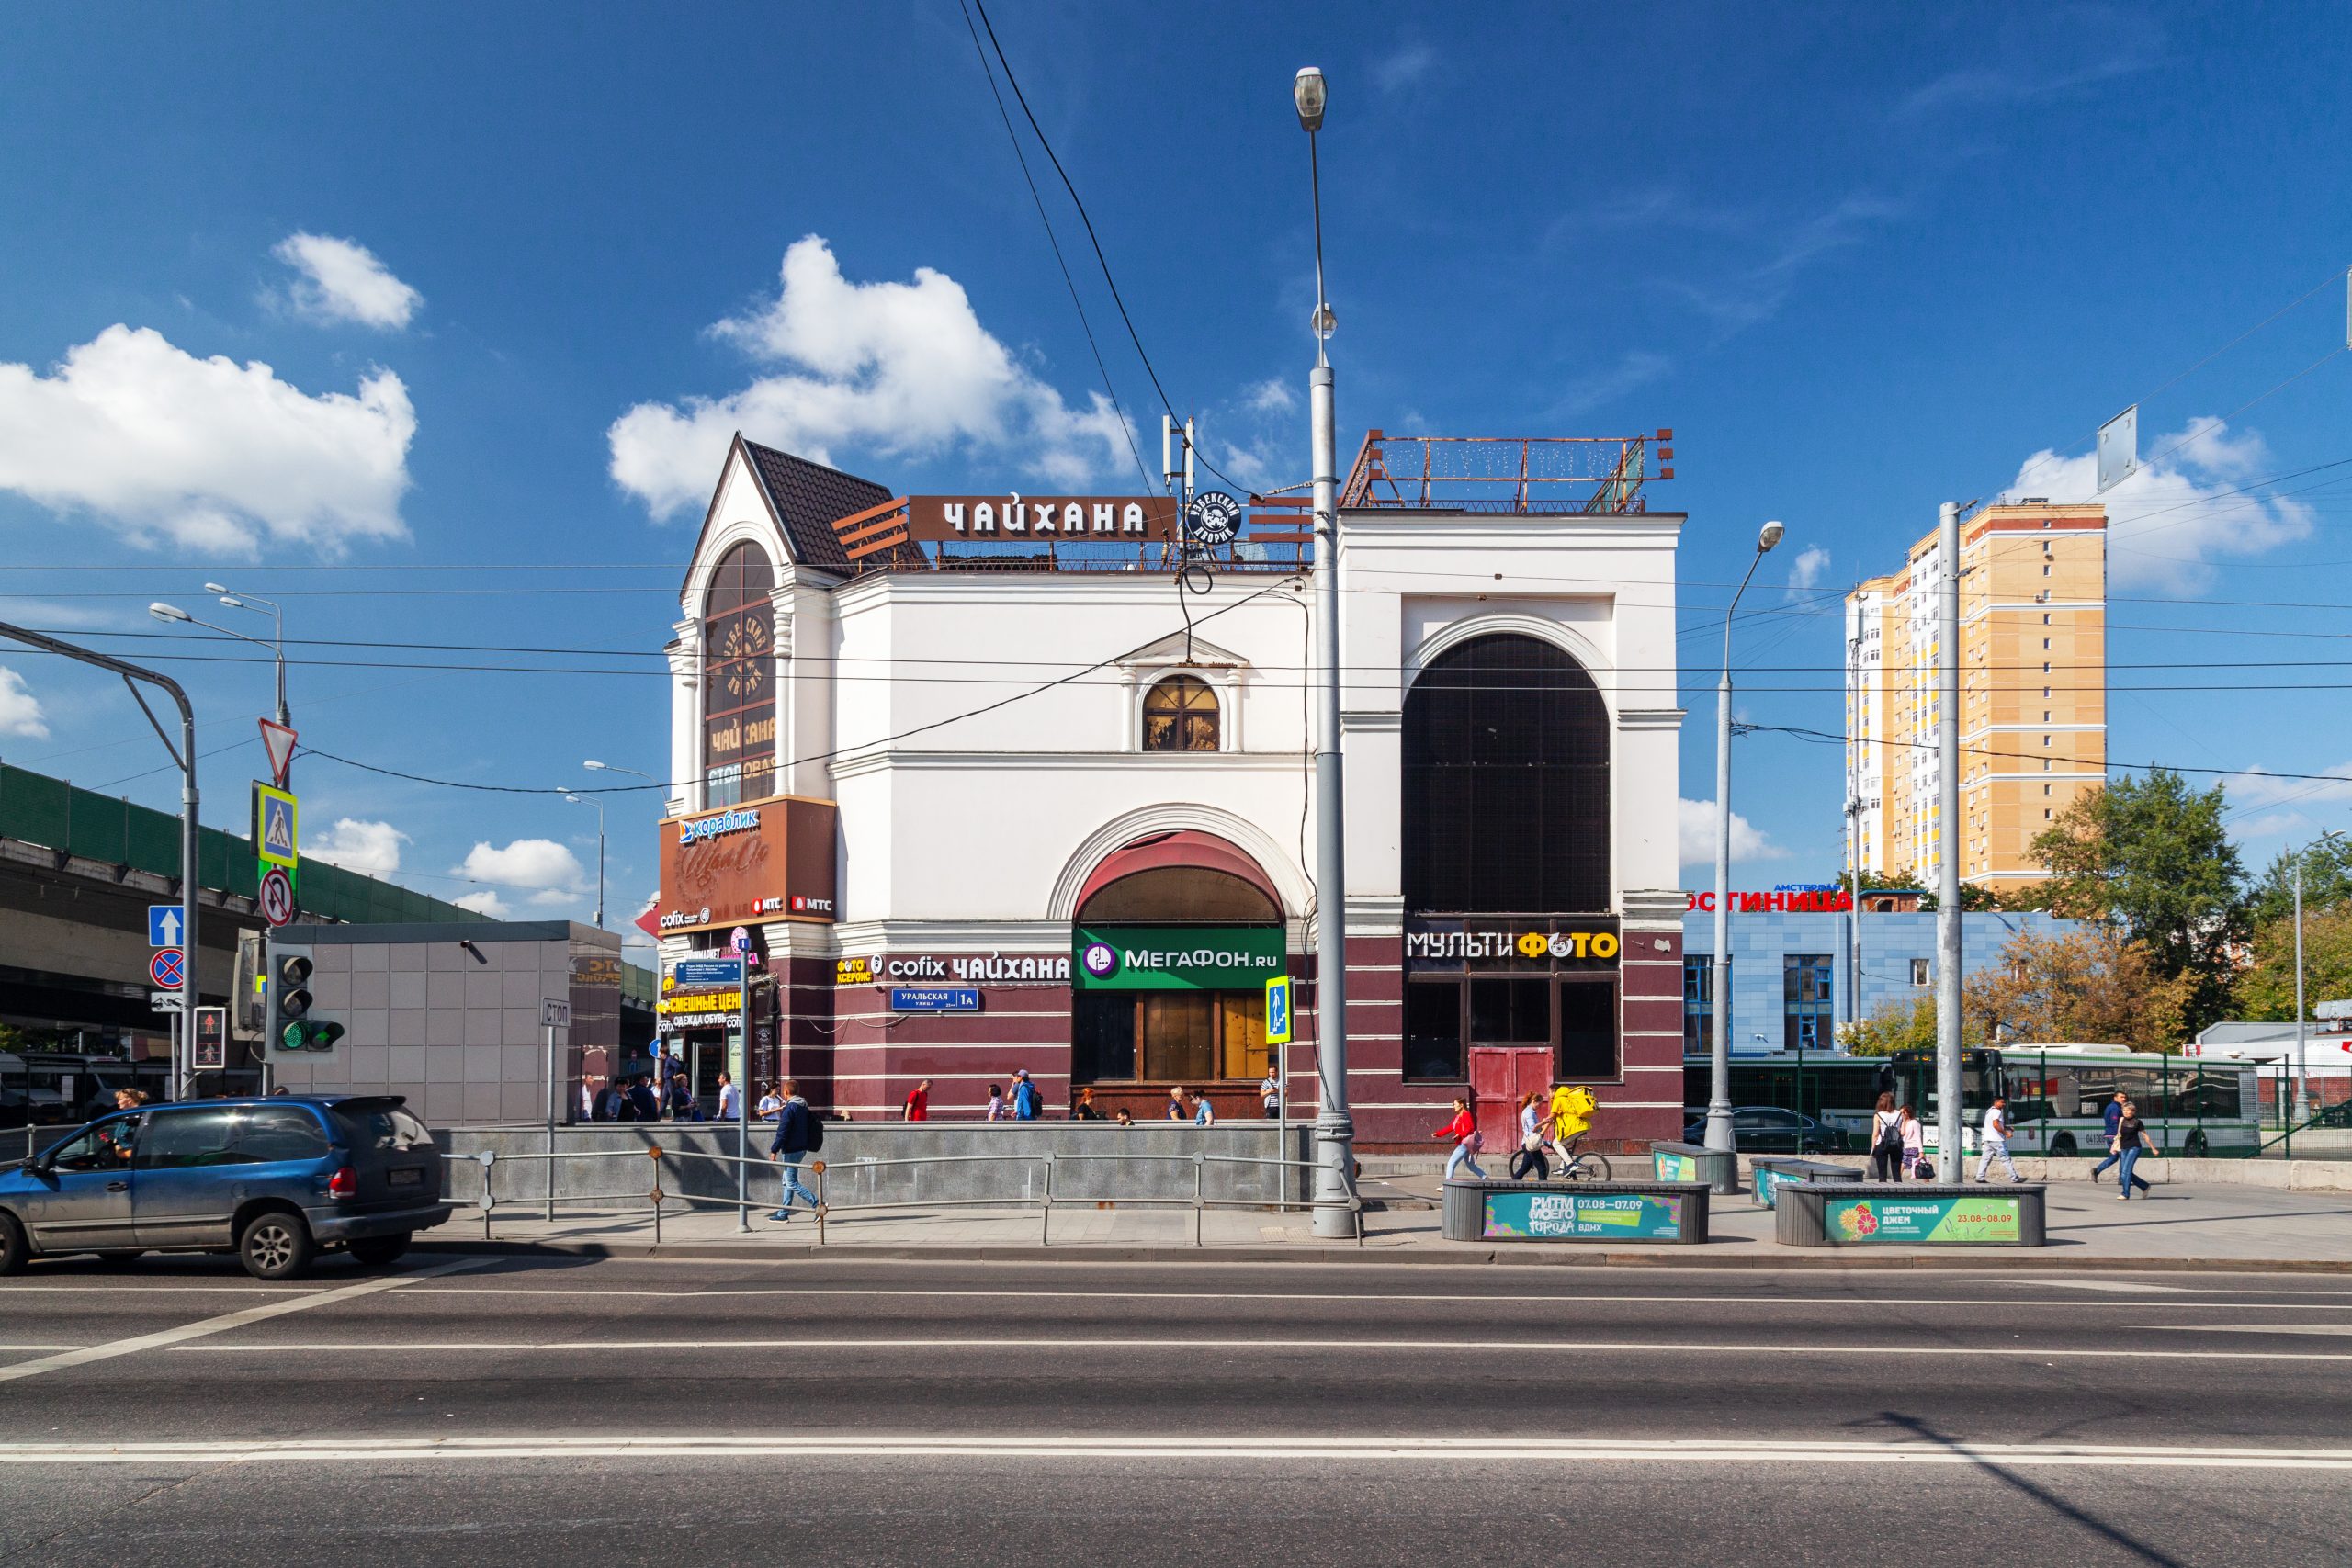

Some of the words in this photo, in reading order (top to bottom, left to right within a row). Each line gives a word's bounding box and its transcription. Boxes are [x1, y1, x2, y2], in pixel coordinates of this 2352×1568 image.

[943, 491, 1144, 532] ЧАЙХАНА
[1190, 492, 1240, 516] УЗБЕКСКИЙ
[1193, 526, 1234, 544] ДВОРИК
[723, 616, 768, 658] УЗБЕСКИЙ
[727, 669, 763, 696] ДВРИК
[694, 809, 760, 839] кораблик
[762, 897, 781, 910] МТС
[806, 897, 831, 911] МТС
[660, 910, 684, 928] cofix
[888, 956, 945, 976] cofix
[953, 951, 1070, 980] ЧАЙХАНА
[837, 971, 872, 983] КСЕРОКС
[670, 995, 718, 1013] СМЕШНЫЕ
[718, 992, 741, 1012] ЦЕН
[960, 994, 974, 1005] 1А
[547, 1003, 568, 1023] СТОП
[673, 1014, 703, 1027] ОДЕЖДА
[704, 1013, 727, 1024] ОБУВЬ
[1531, 1196, 1574, 1210] РИТМ
[1882, 1205, 1939, 1215] ЦВЕТОЧНЫЙ
[1529, 1208, 1576, 1221] МОЕГО
[1882, 1215, 1911, 1224] ДЖЕМ
[1578, 1224, 1602, 1233] ВДНХ
